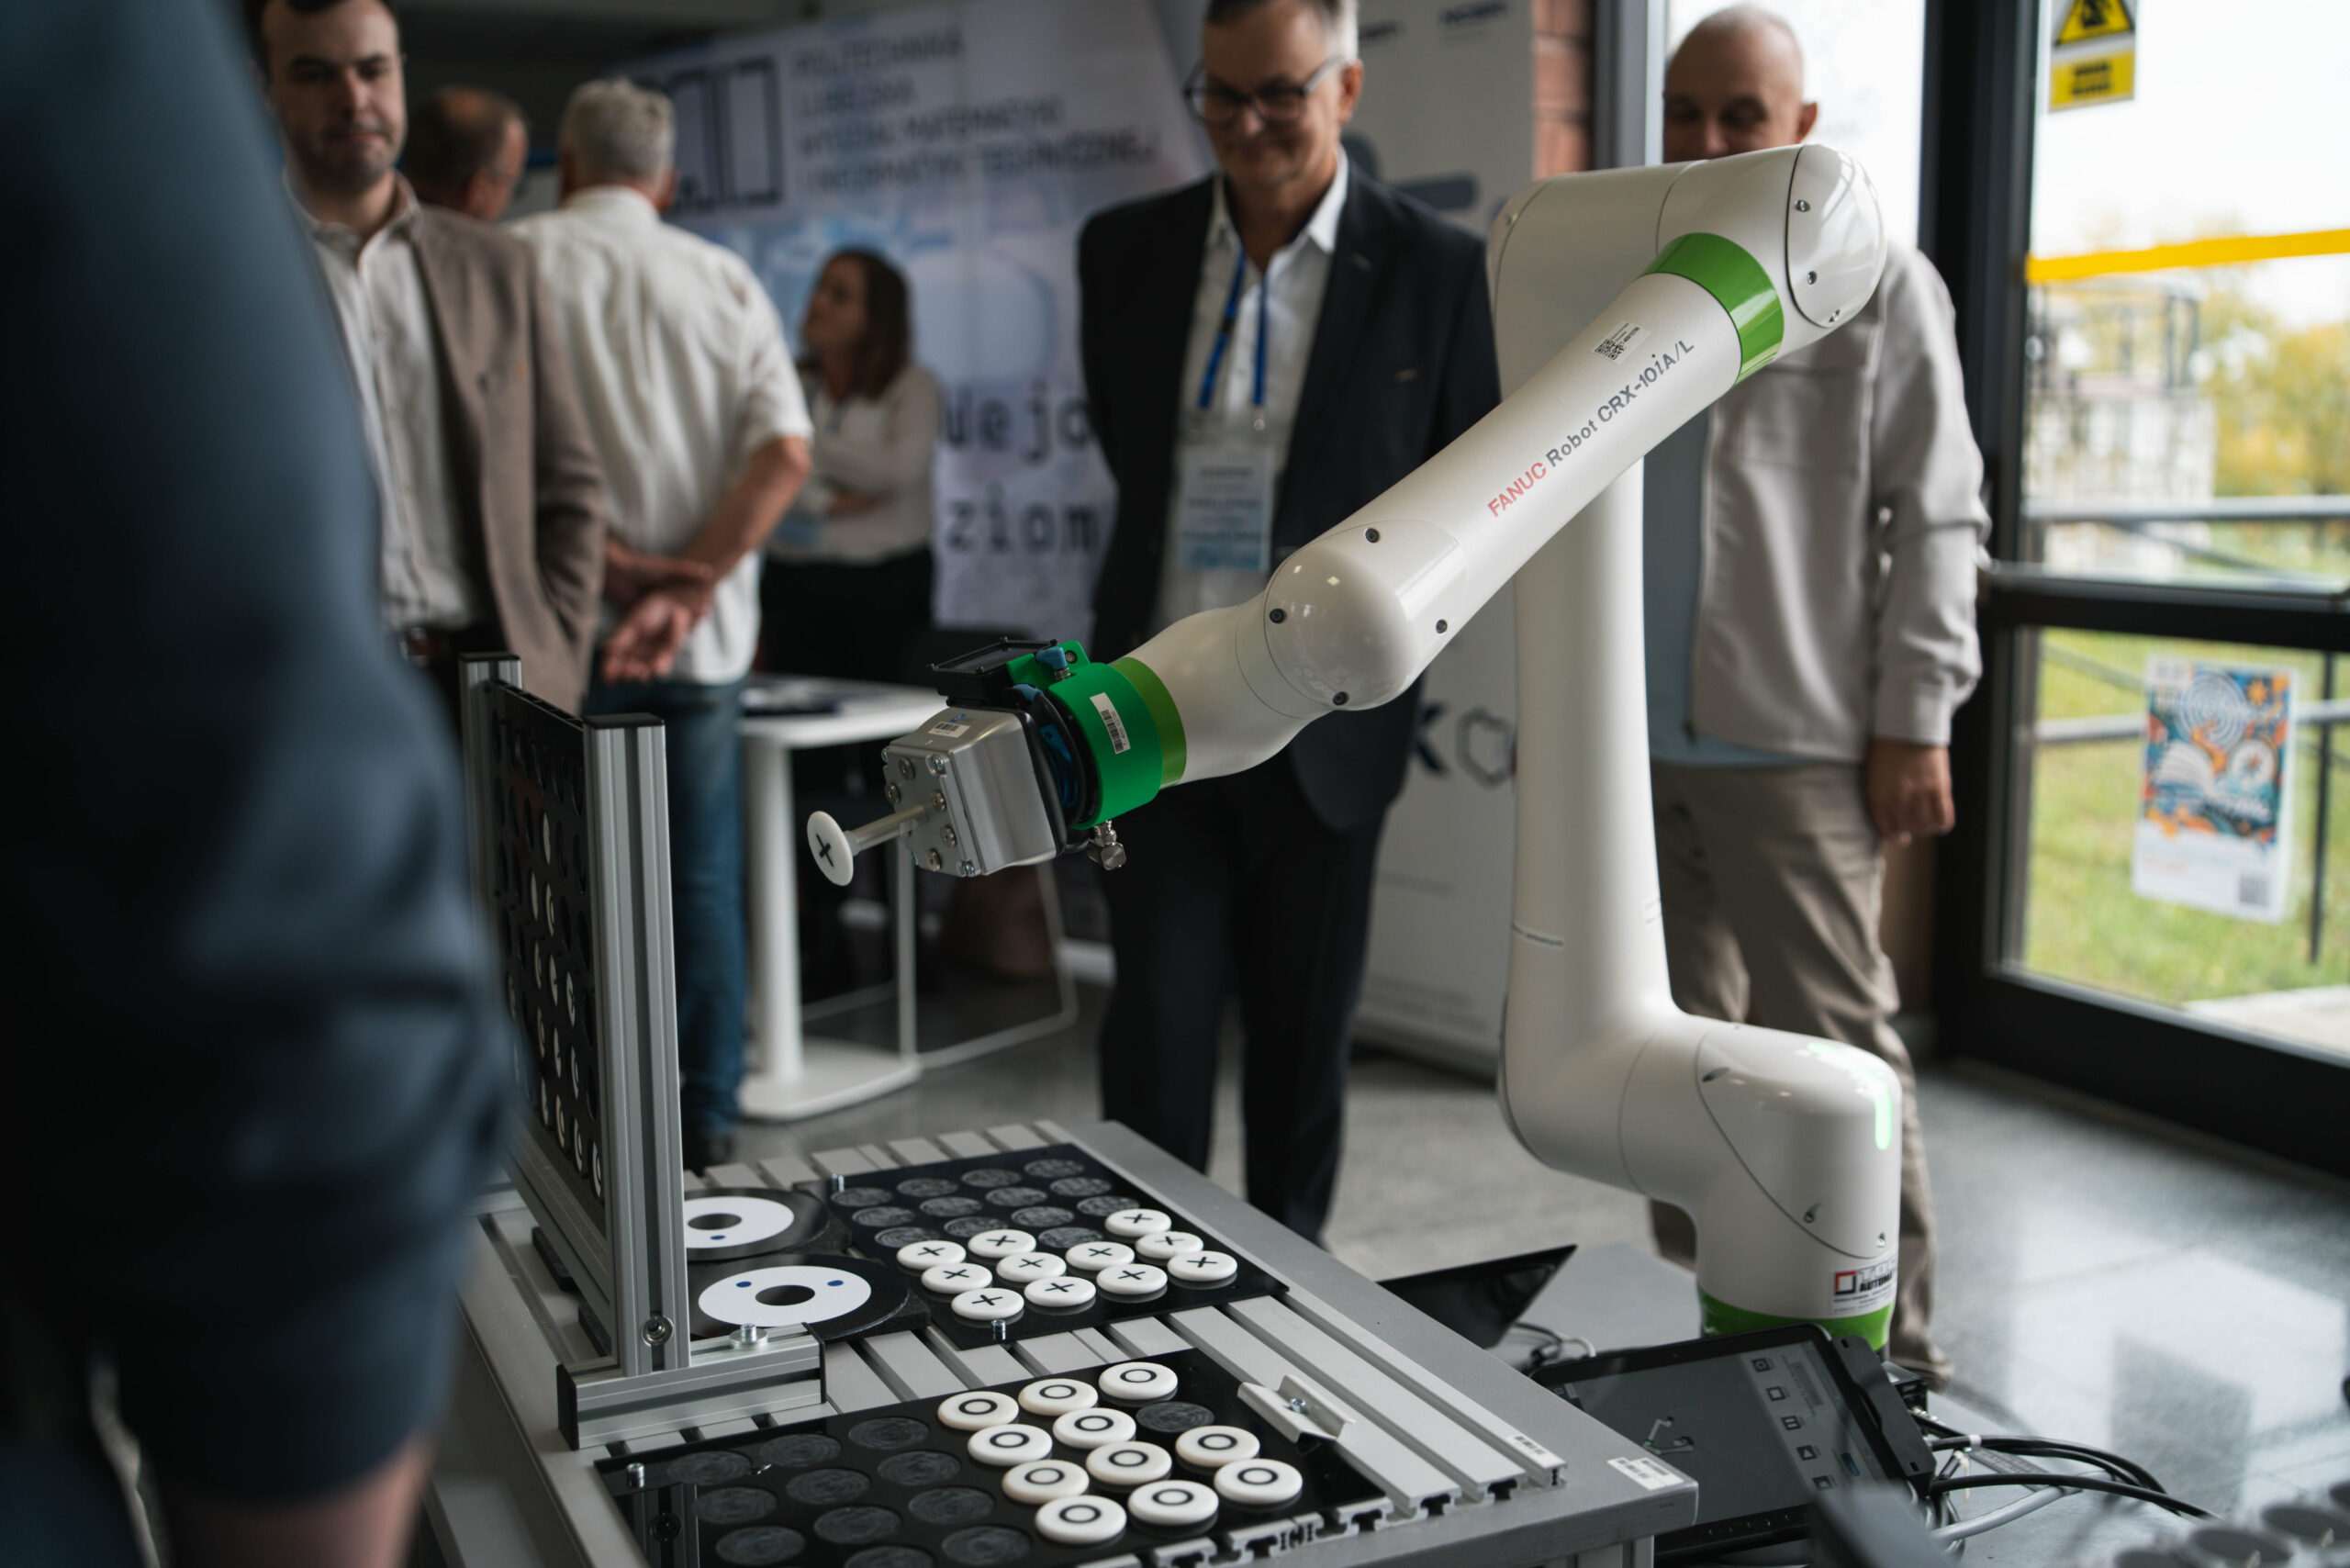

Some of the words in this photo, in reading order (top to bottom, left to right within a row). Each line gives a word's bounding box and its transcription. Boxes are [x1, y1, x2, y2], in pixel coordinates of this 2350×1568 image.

[1487, 462, 1548, 517] FANUC
[1546, 420, 1598, 467] Robot
[1597, 339, 1695, 422] CRX-10iA/L
